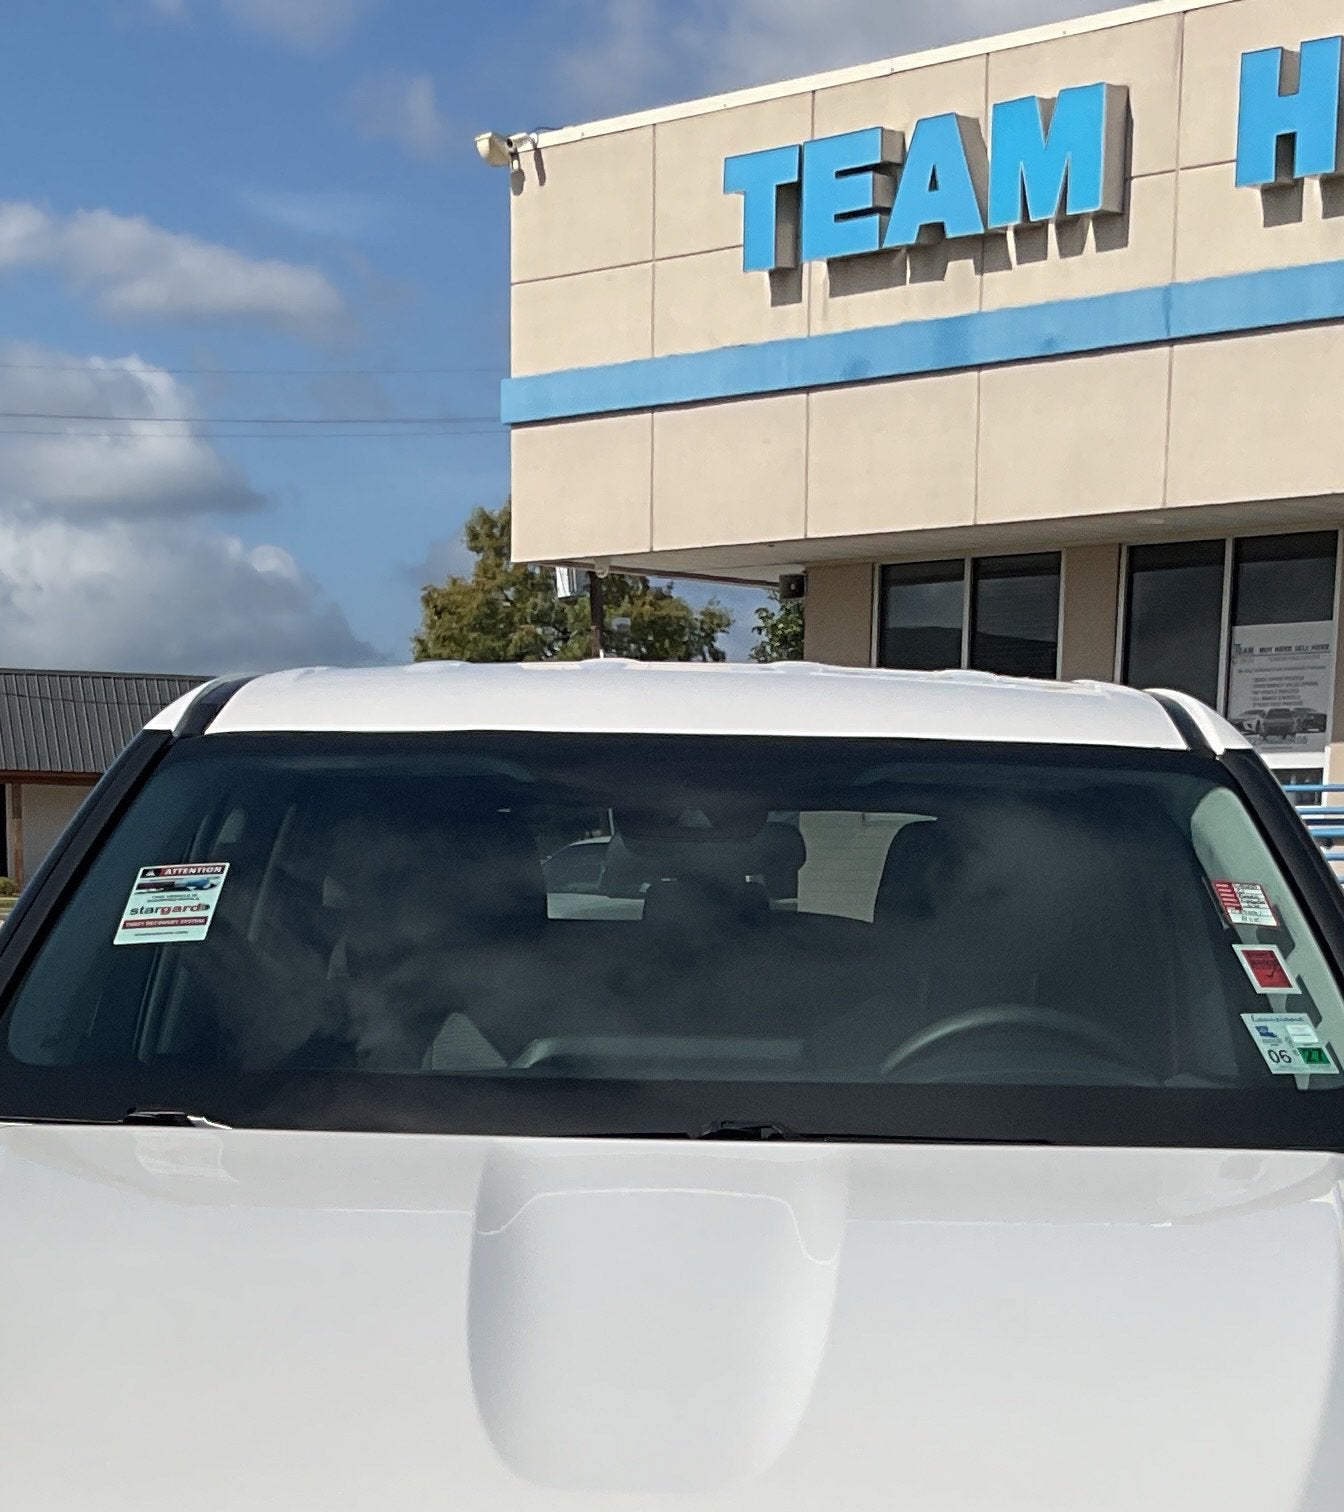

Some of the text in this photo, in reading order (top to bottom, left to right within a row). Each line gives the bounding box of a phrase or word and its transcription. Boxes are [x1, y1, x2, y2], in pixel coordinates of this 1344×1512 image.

[724, 82, 1126, 272] TEAM
[164, 866, 222, 875] ATTENTION
[1267, 1049, 1292, 1064] 06
